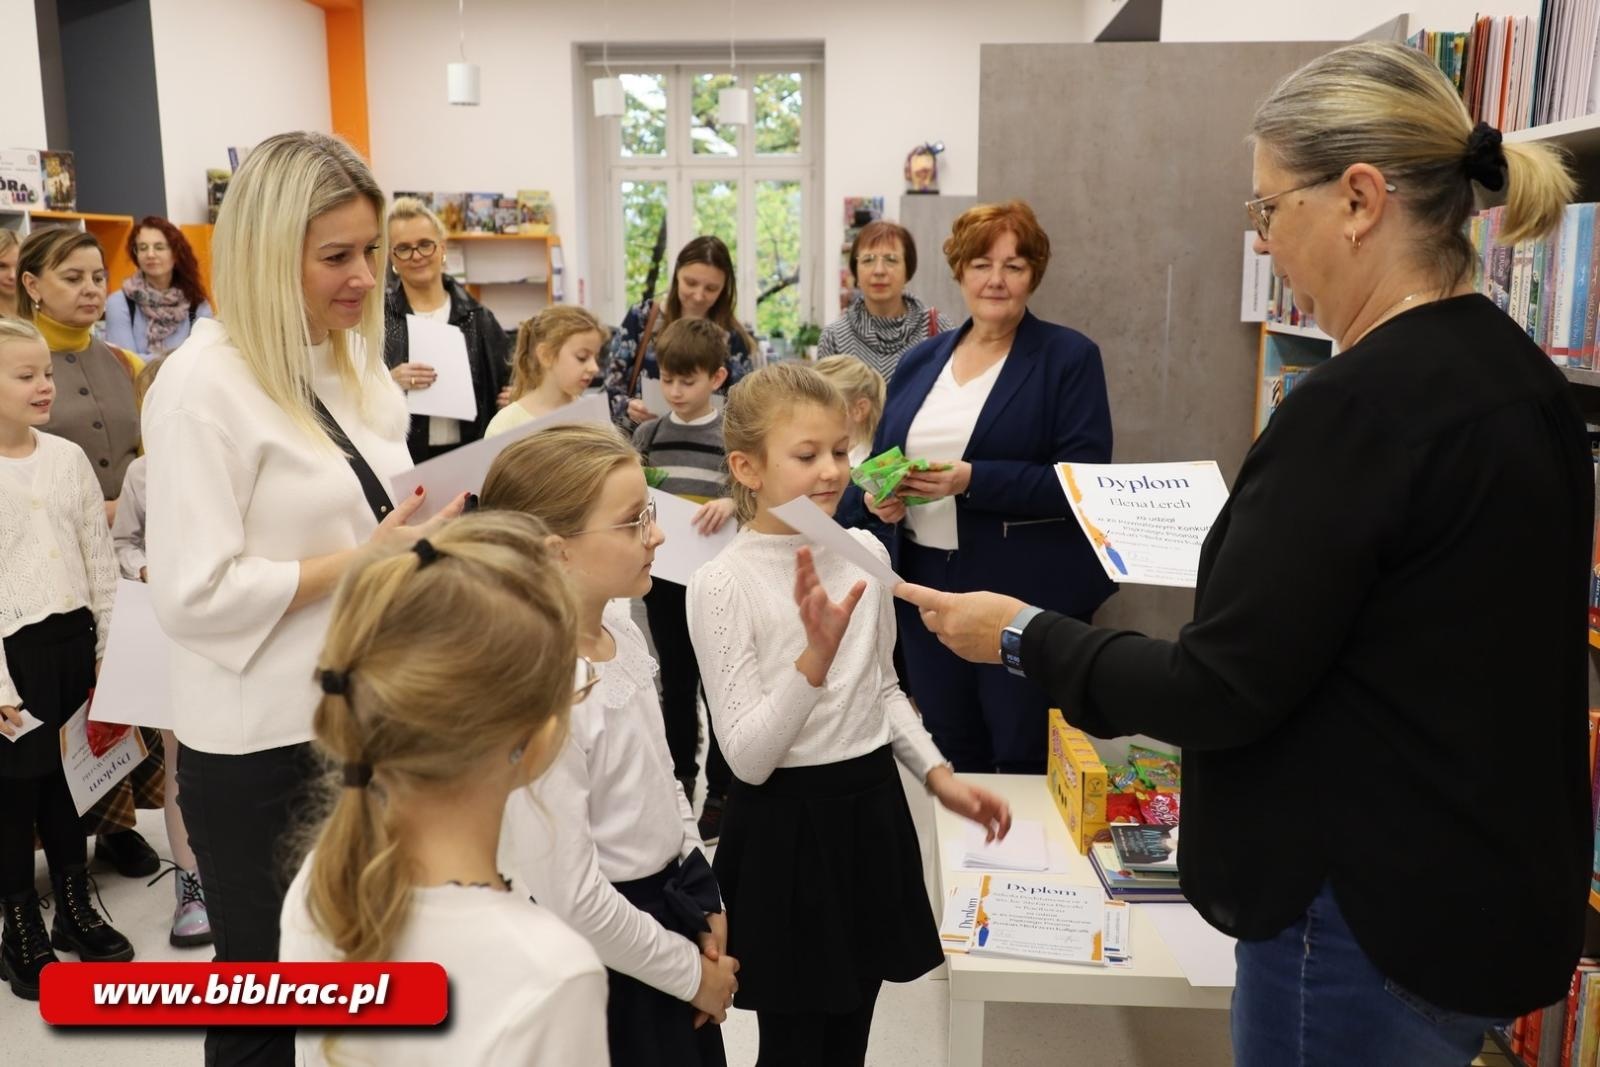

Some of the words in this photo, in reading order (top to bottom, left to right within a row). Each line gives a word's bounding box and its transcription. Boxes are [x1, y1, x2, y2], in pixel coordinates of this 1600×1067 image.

[1097, 475, 1190, 493] Dyplom
[1109, 498, 1148, 508] Elena
[1150, 499, 1191, 509] Lerch
[1178, 525, 1212, 533] Konkur
[89, 752, 132, 792] Dyplom
[1007, 883, 1077, 896] Dyplom
